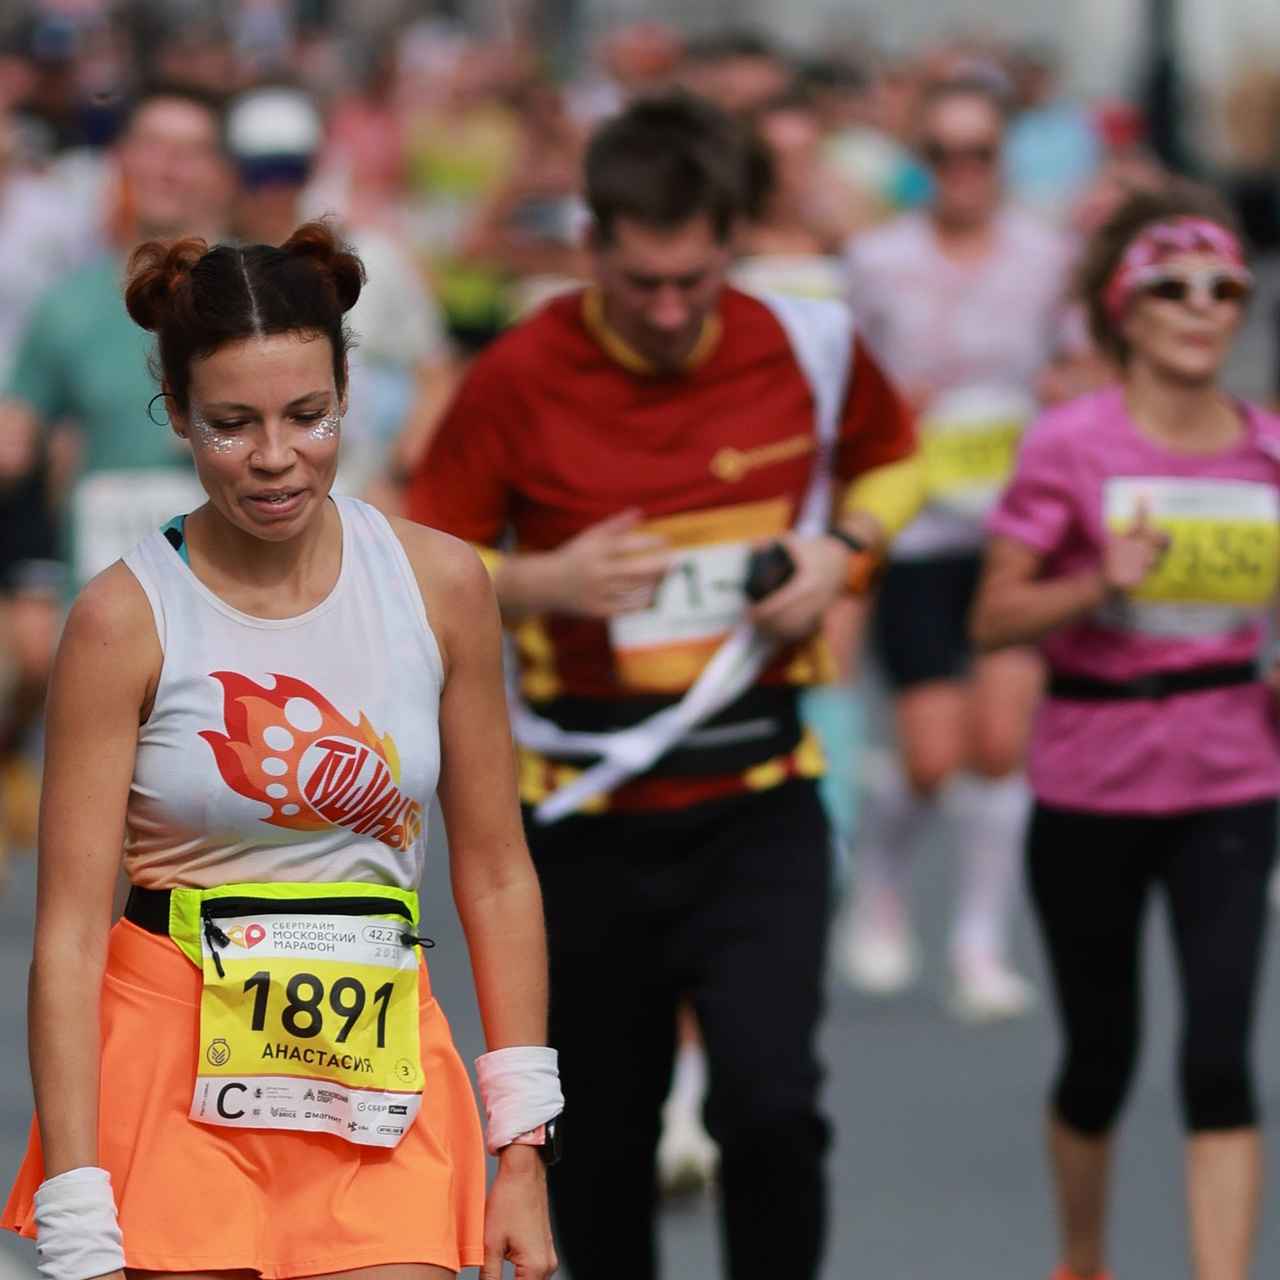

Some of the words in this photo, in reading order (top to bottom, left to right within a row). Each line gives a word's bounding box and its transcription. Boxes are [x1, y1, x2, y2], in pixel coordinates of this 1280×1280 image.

[272, 922, 335, 931] СБЕРПРАЙМ
[273, 931, 356, 943] МОСКОВСКИЙ
[369, 930, 393, 942] 42,2
[274, 941, 335, 953] МАРАФОН
[243, 971, 395, 1049] 1891
[262, 1042, 374, 1073] АНАСТАСИЯ
[402, 1066, 409, 1076] 3
[367, 1104, 388, 1112] СБЕР
